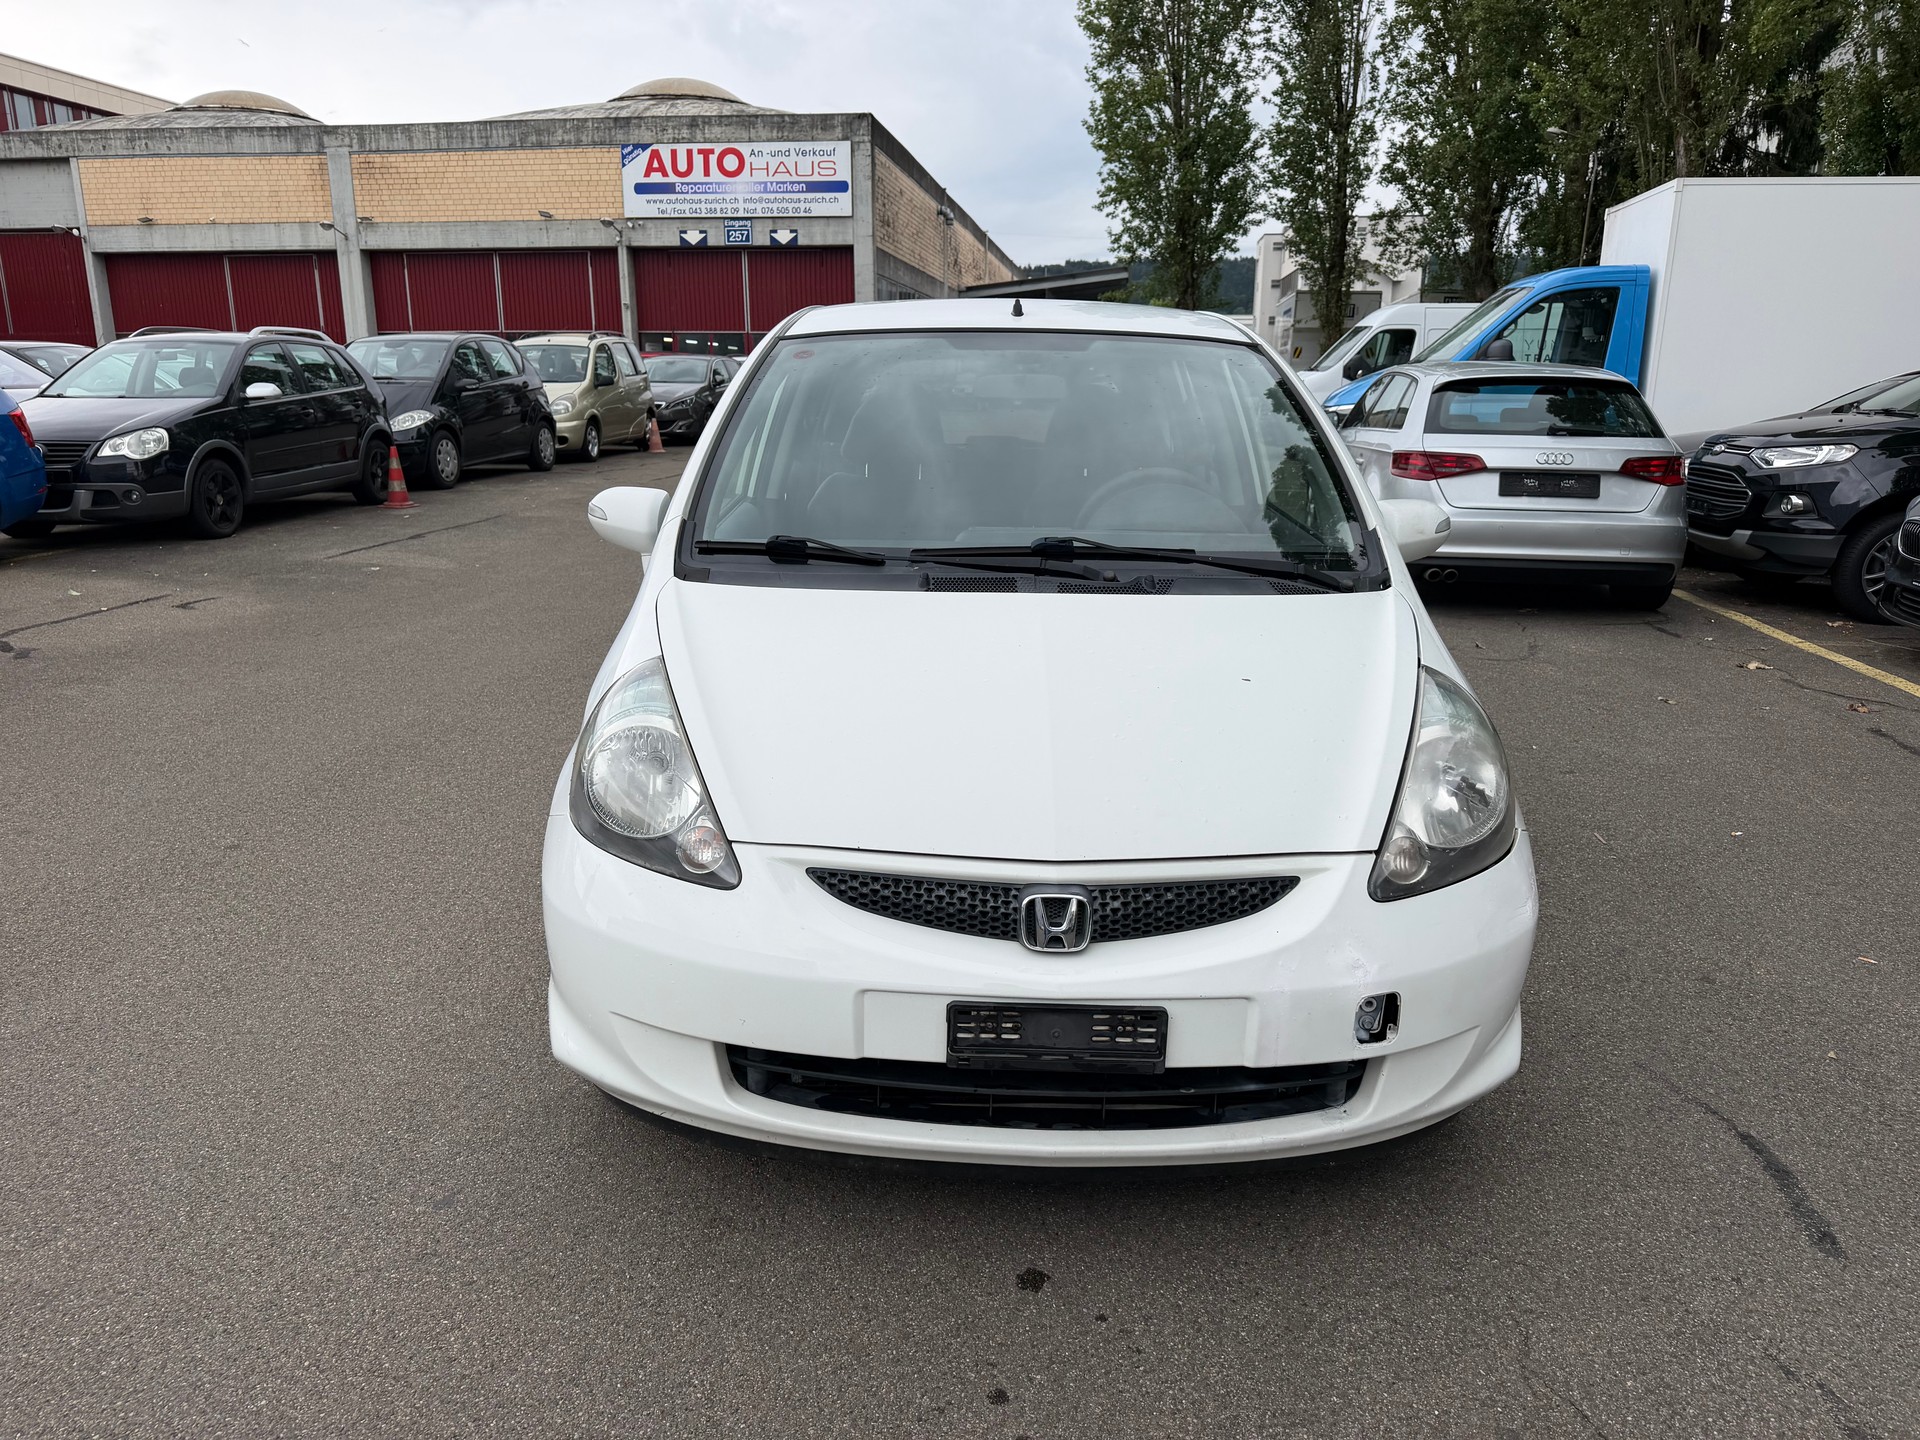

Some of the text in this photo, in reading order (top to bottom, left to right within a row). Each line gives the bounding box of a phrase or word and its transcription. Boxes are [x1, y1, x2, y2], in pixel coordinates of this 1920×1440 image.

[621, 144, 634, 155] Hier
[749, 148, 764, 158] An
[793, 147, 836, 157] Verkauf
[643, 147, 837, 178] AUTO HAUS
[766, 181, 806, 192] Marken
[645, 196, 839, 205] www.autohaus-zurich.ch info@autohaus-zurich.ch
[688, 207, 702, 215] 043
[704, 207, 718, 215] 388
[719, 207, 729, 215] 82
[731, 206, 740, 215] 09
[761, 206, 775, 215] 076
[776, 206, 790, 214] 505
[791, 206, 801, 214] 00
[802, 206, 813, 214] 46
[724, 219, 752, 228] Eingang
[728, 230, 748, 241] 257
